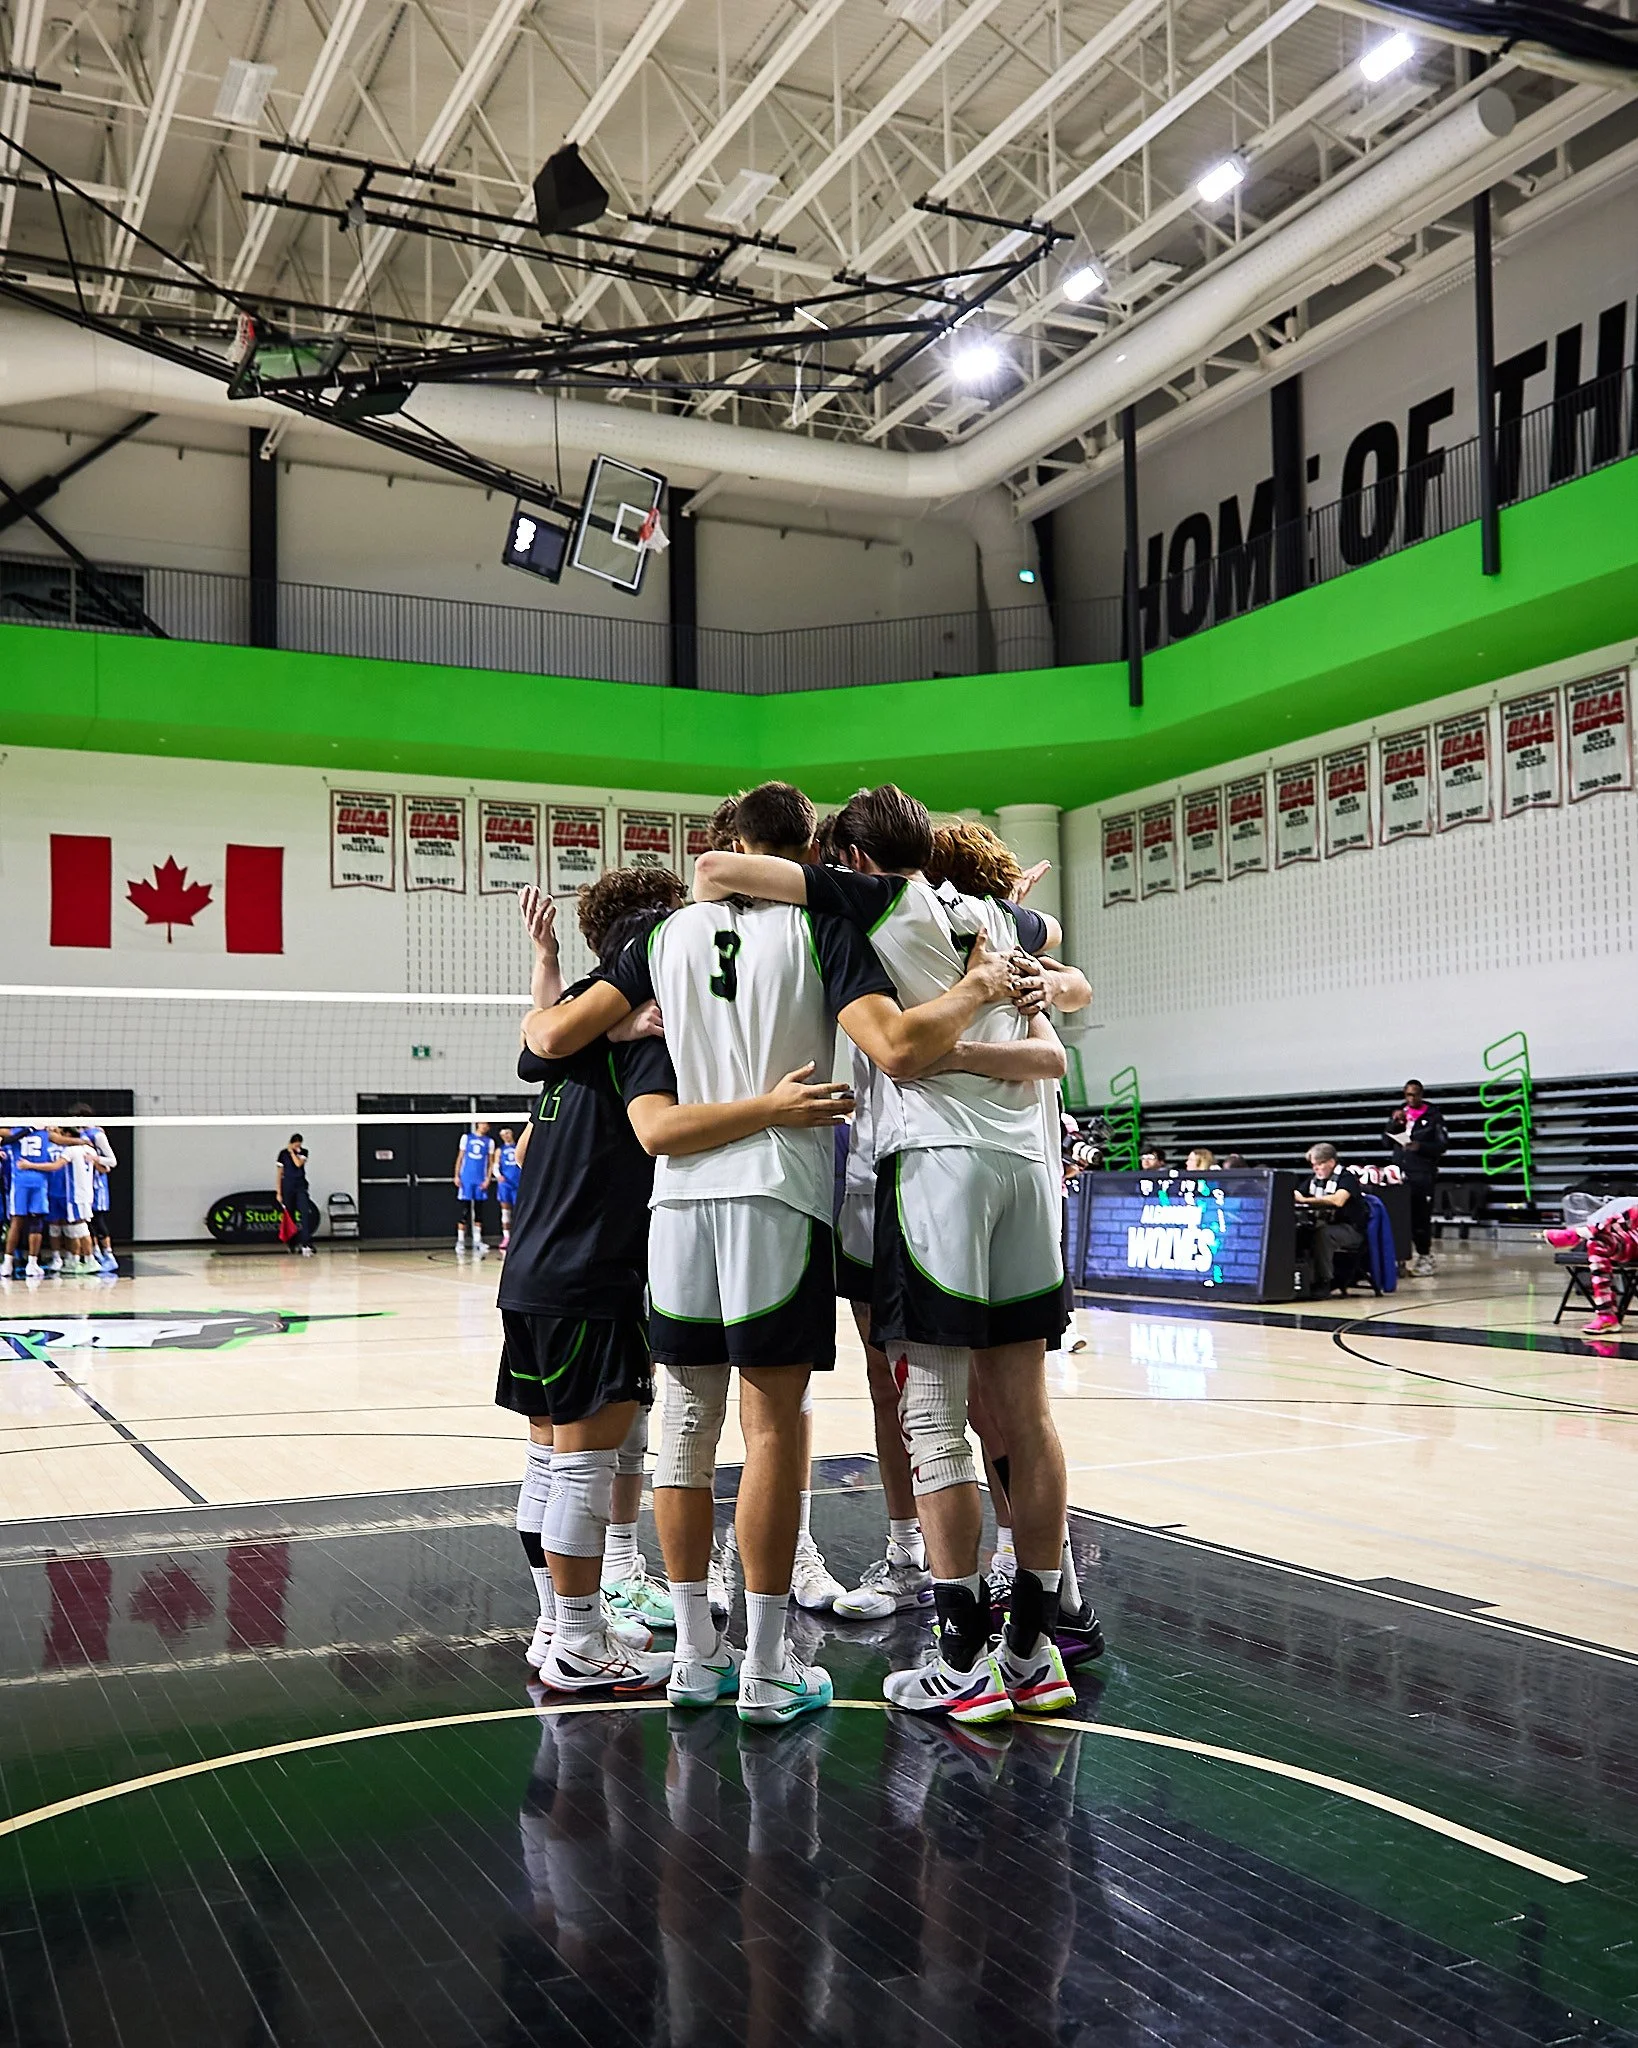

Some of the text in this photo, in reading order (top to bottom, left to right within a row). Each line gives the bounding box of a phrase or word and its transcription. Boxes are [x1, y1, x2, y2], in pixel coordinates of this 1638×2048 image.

[1121, 285, 1638, 661] HOM OF TH
[1573, 689, 1623, 721] OCAA
[1508, 709, 1553, 738] OCAA
[1572, 709, 1625, 736] CHAMPIONS
[1441, 729, 1484, 756] OCAA
[1587, 729, 1611, 742] MEN'S
[1520, 747, 1542, 759] MEN'S
[1582, 737, 1616, 753] SOCCER
[1385, 746, 1425, 772] OCAA
[1516, 755, 1546, 770] SOCCER
[1392, 788, 1418, 801] SOCCER
[338, 808, 388, 824] OCAA
[410, 812, 459, 828] OCAA
[486, 817, 534, 833] OCAA
[554, 821, 599, 837] OCAA
[352, 837, 375, 845] MEN'S
[625, 826, 669, 842] OCAA
[342, 844, 385, 853] VOLLEYBALL
[414, 848, 456, 857] VOLLEYBALL
[489, 852, 530, 861] VOLLEYBALL
[490, 880, 527, 889] 1977-197
[710, 930, 741, 1002] 3
[20, 1135, 42, 1157] 12
[245, 1209, 302, 1222] Studet
[1127, 1226, 1215, 1273] WOLVES
